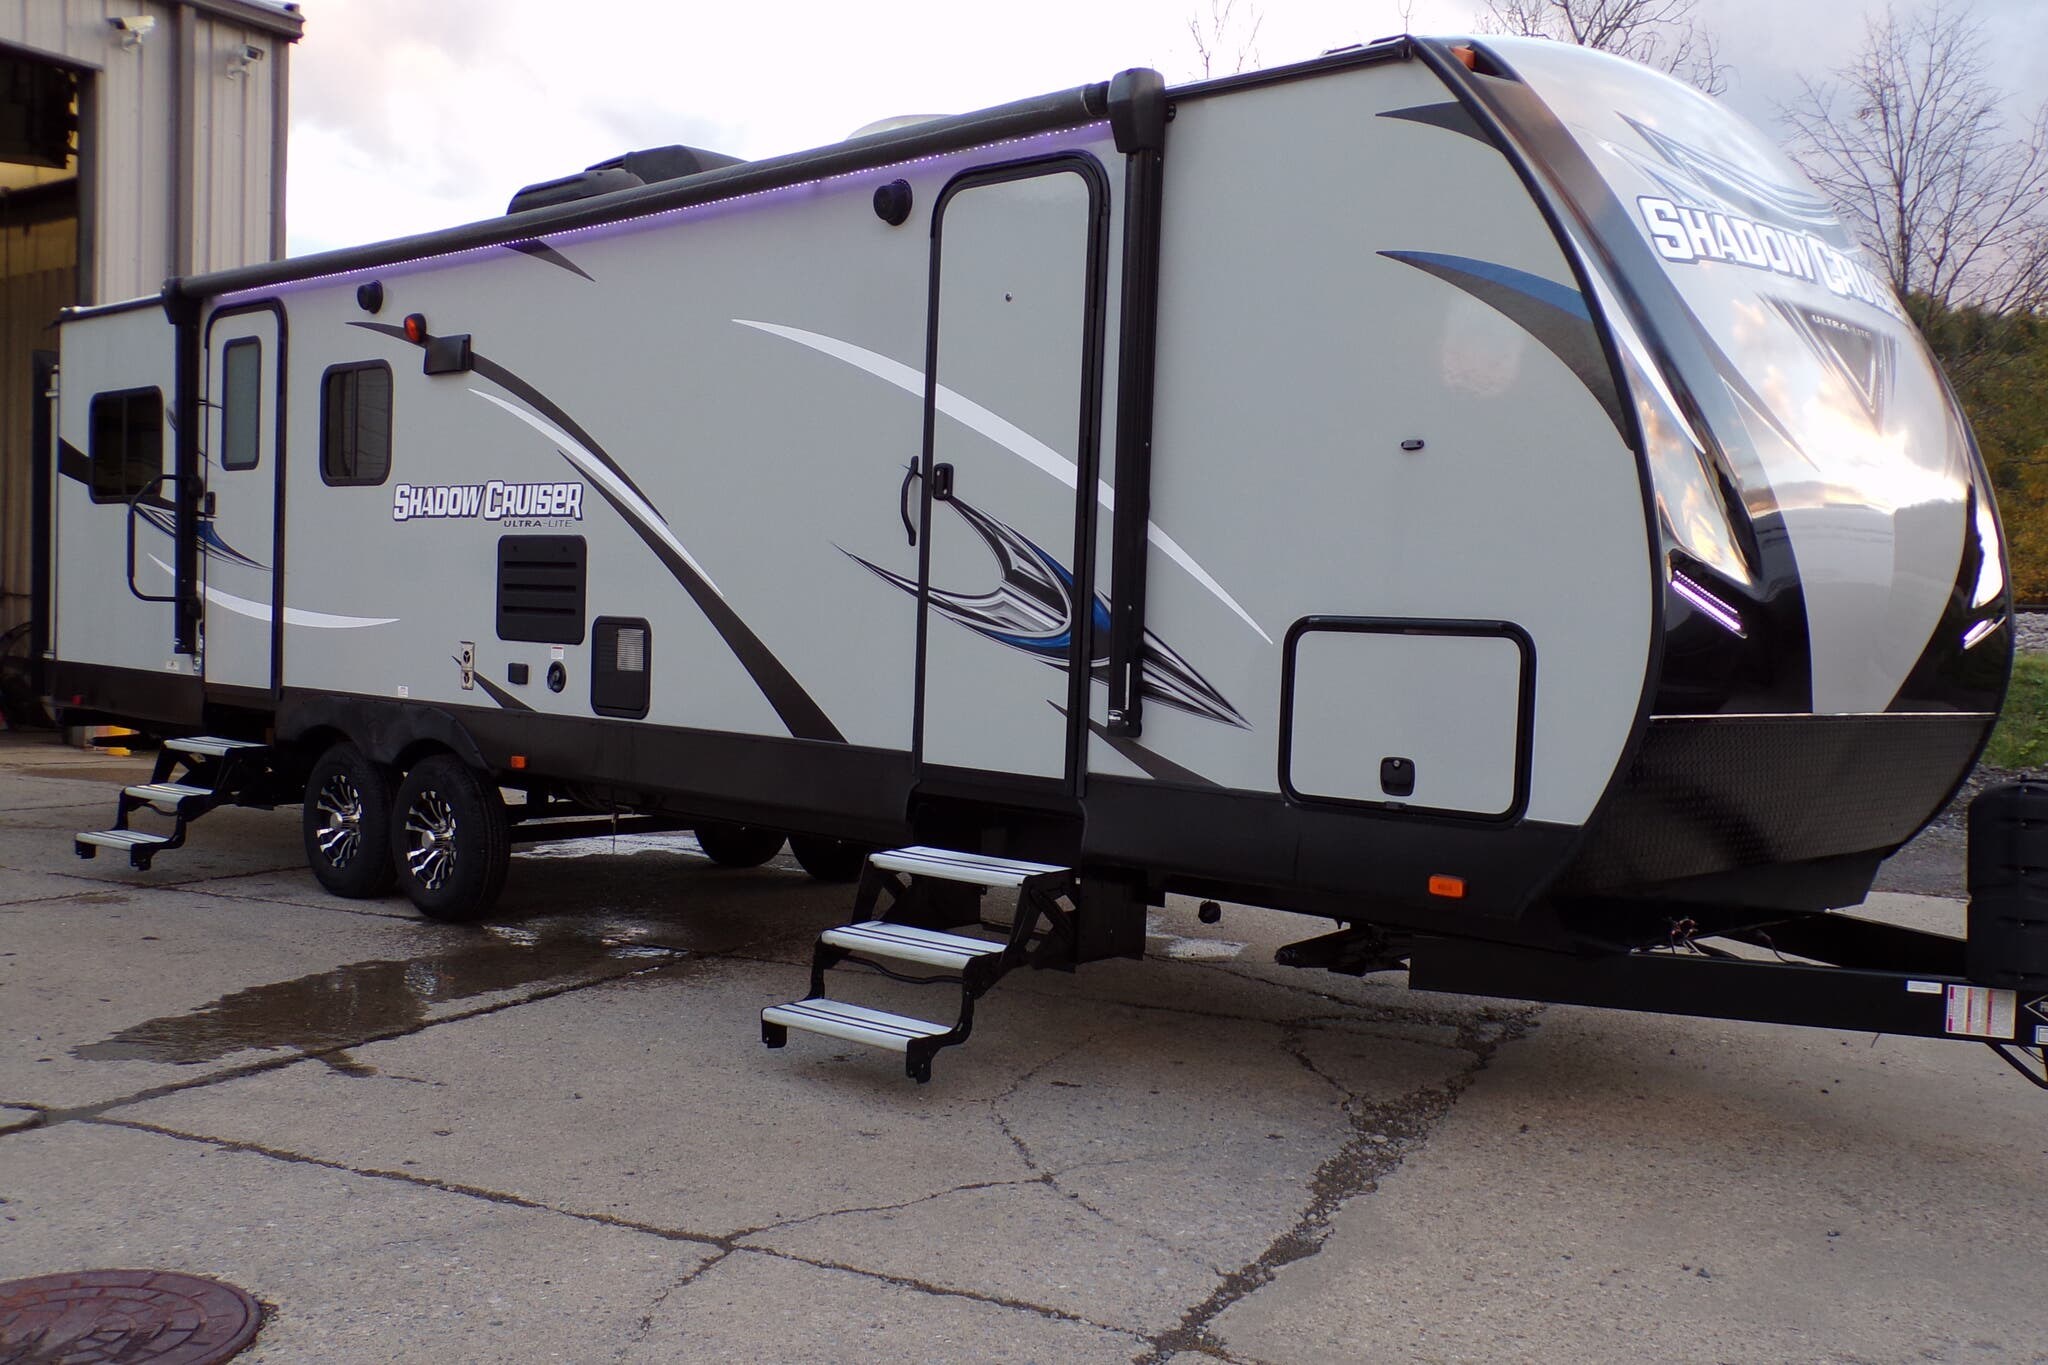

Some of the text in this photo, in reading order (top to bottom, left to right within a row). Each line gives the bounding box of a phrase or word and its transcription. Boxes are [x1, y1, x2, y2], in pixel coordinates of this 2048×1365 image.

[1636, 195, 1818, 284] SHADOW
[393, 480, 584, 521] SHADOW CRUISER
[503, 519, 574, 528] ULTRA-LITE
